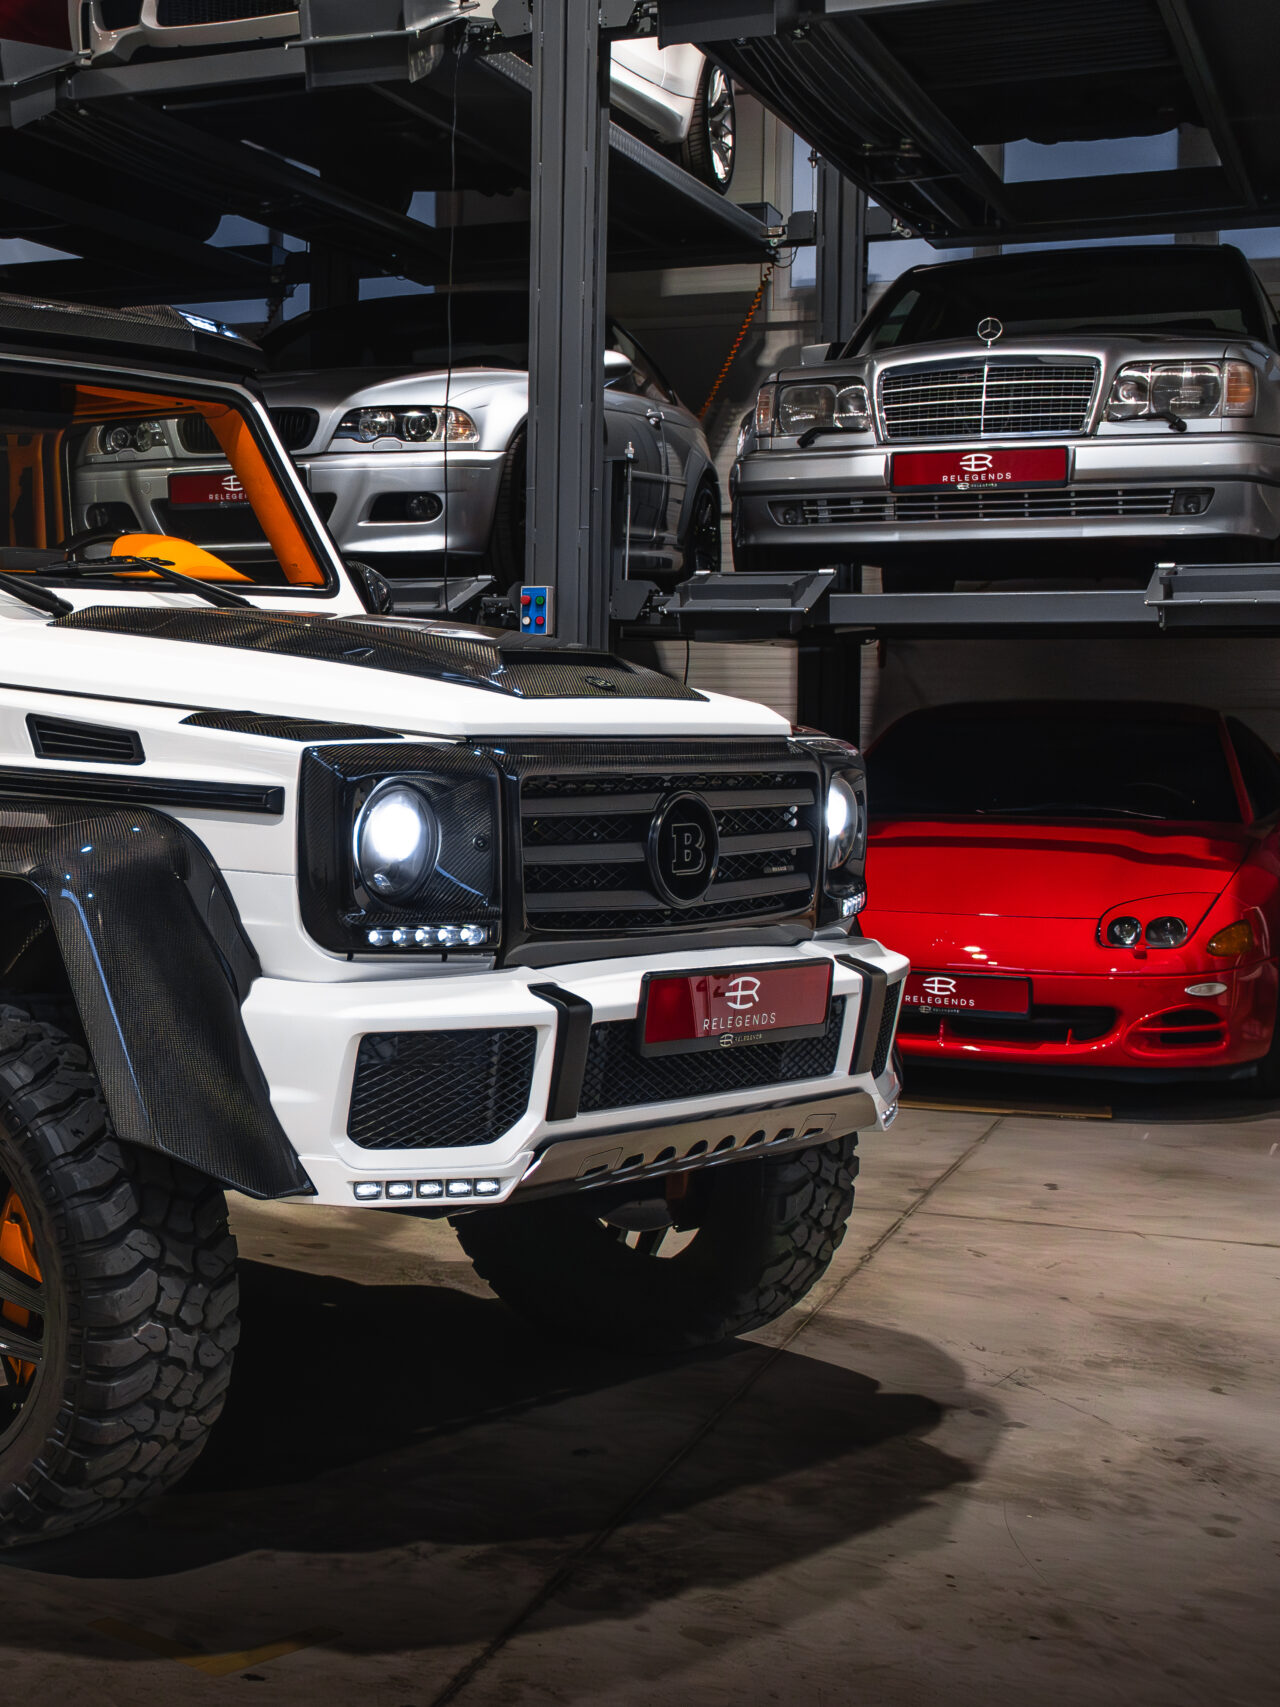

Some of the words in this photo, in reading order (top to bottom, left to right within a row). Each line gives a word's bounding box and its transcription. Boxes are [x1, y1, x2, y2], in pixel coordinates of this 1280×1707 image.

[942, 472, 1012, 482] RELEGENDS
[671, 822, 707, 876] B
[905, 994, 976, 1007] RELEGENDS
[703, 1012, 776, 1031] RELEGENDS
